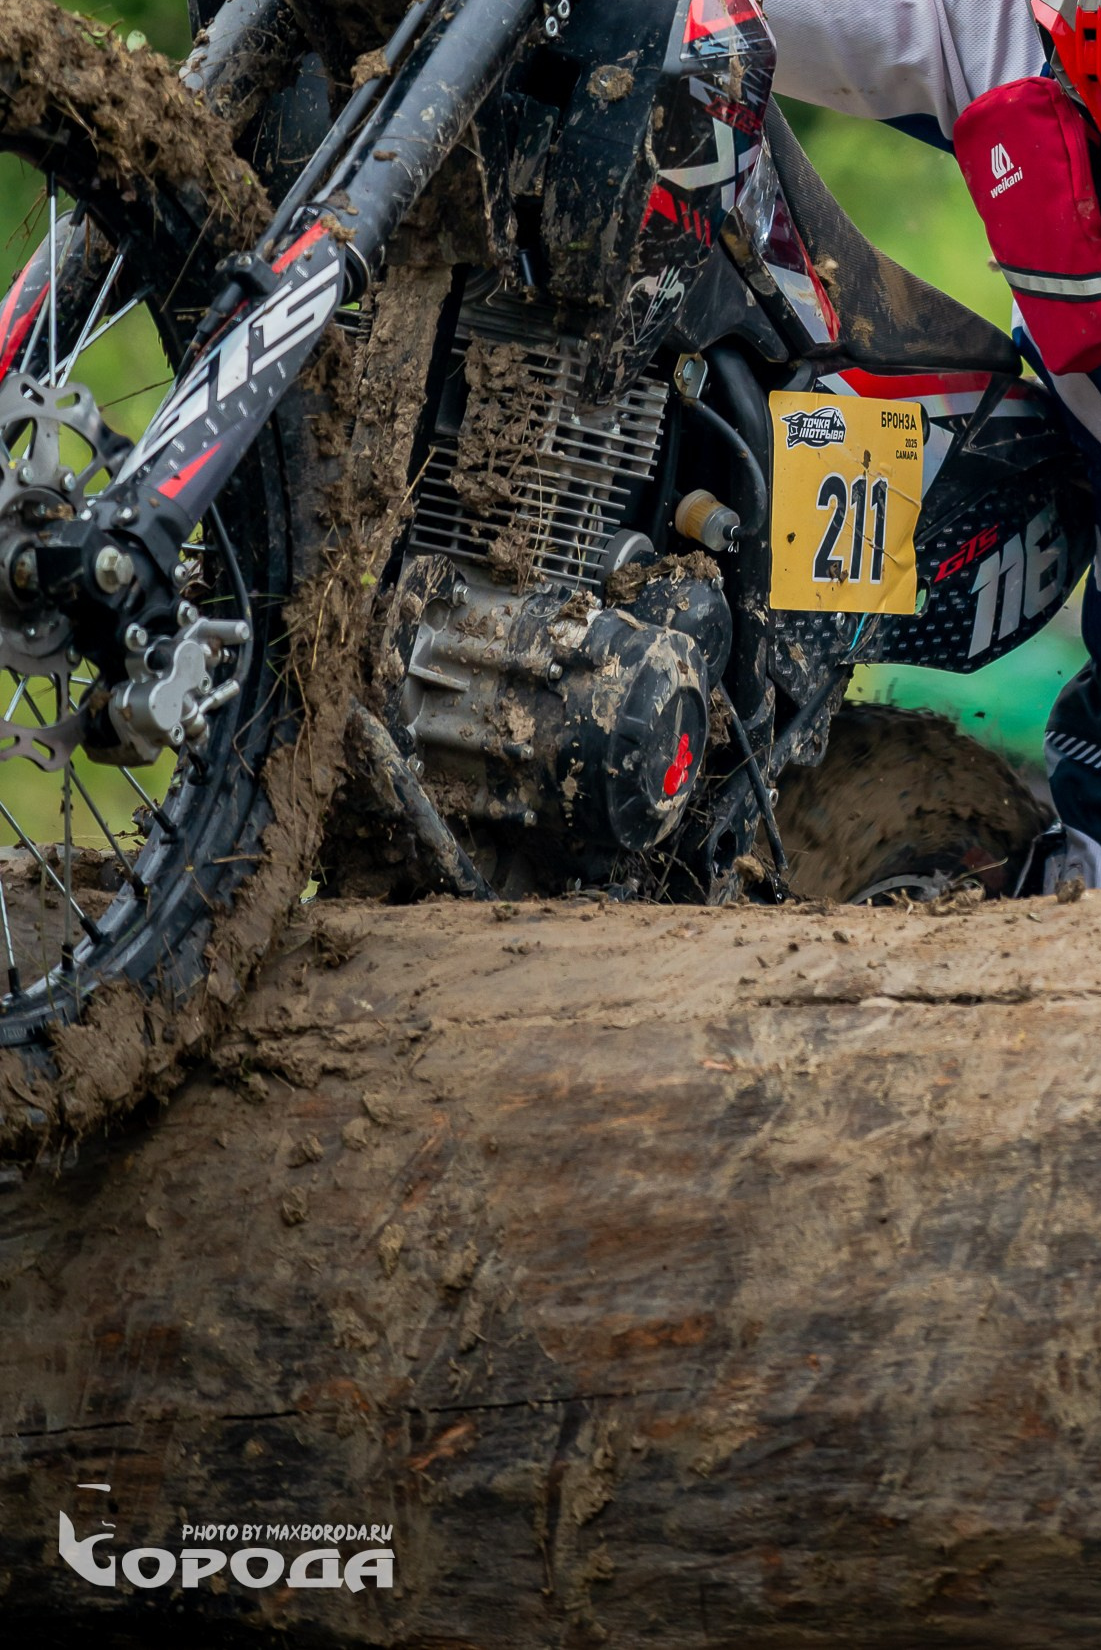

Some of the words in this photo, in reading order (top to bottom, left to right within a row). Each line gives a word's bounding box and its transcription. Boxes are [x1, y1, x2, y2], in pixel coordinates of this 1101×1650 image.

[990, 166, 1023, 199] weikani
[802, 417, 831, 430] ТОЧКА
[881, 411, 917, 431] БРОНЗА
[905, 438, 918, 449] 2025
[895, 450, 918, 461] САМАРА
[812, 472, 889, 585] 211
[933, 523, 999, 583] GTS
